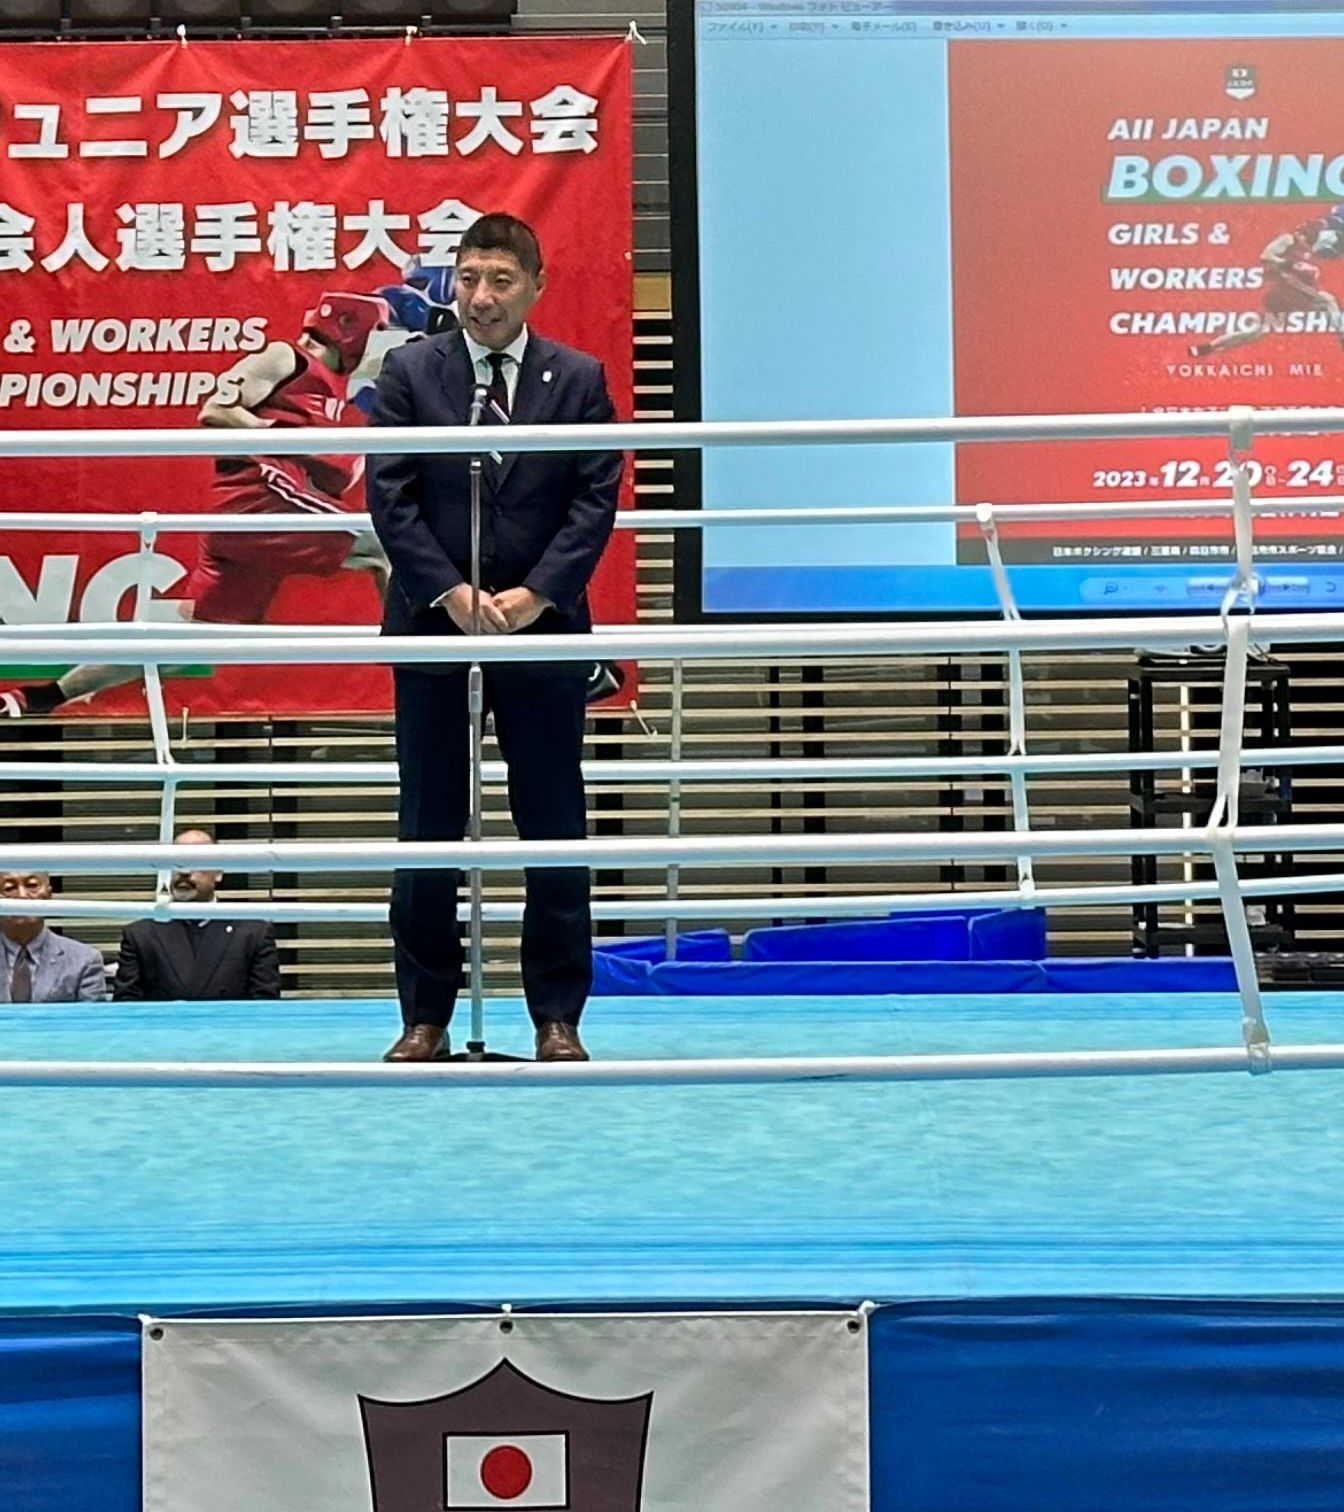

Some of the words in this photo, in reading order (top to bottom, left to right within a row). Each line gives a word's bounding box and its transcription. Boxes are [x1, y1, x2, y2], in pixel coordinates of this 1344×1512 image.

[1161, 117, 1269, 140] JAPAN
[1108, 223, 1200, 245] GIRLS
[1208, 223, 1230, 245] &
[1109, 267, 1264, 290] WORKERS
[3, 319, 35, 355] &
[51, 317, 268, 354] WORKERS
